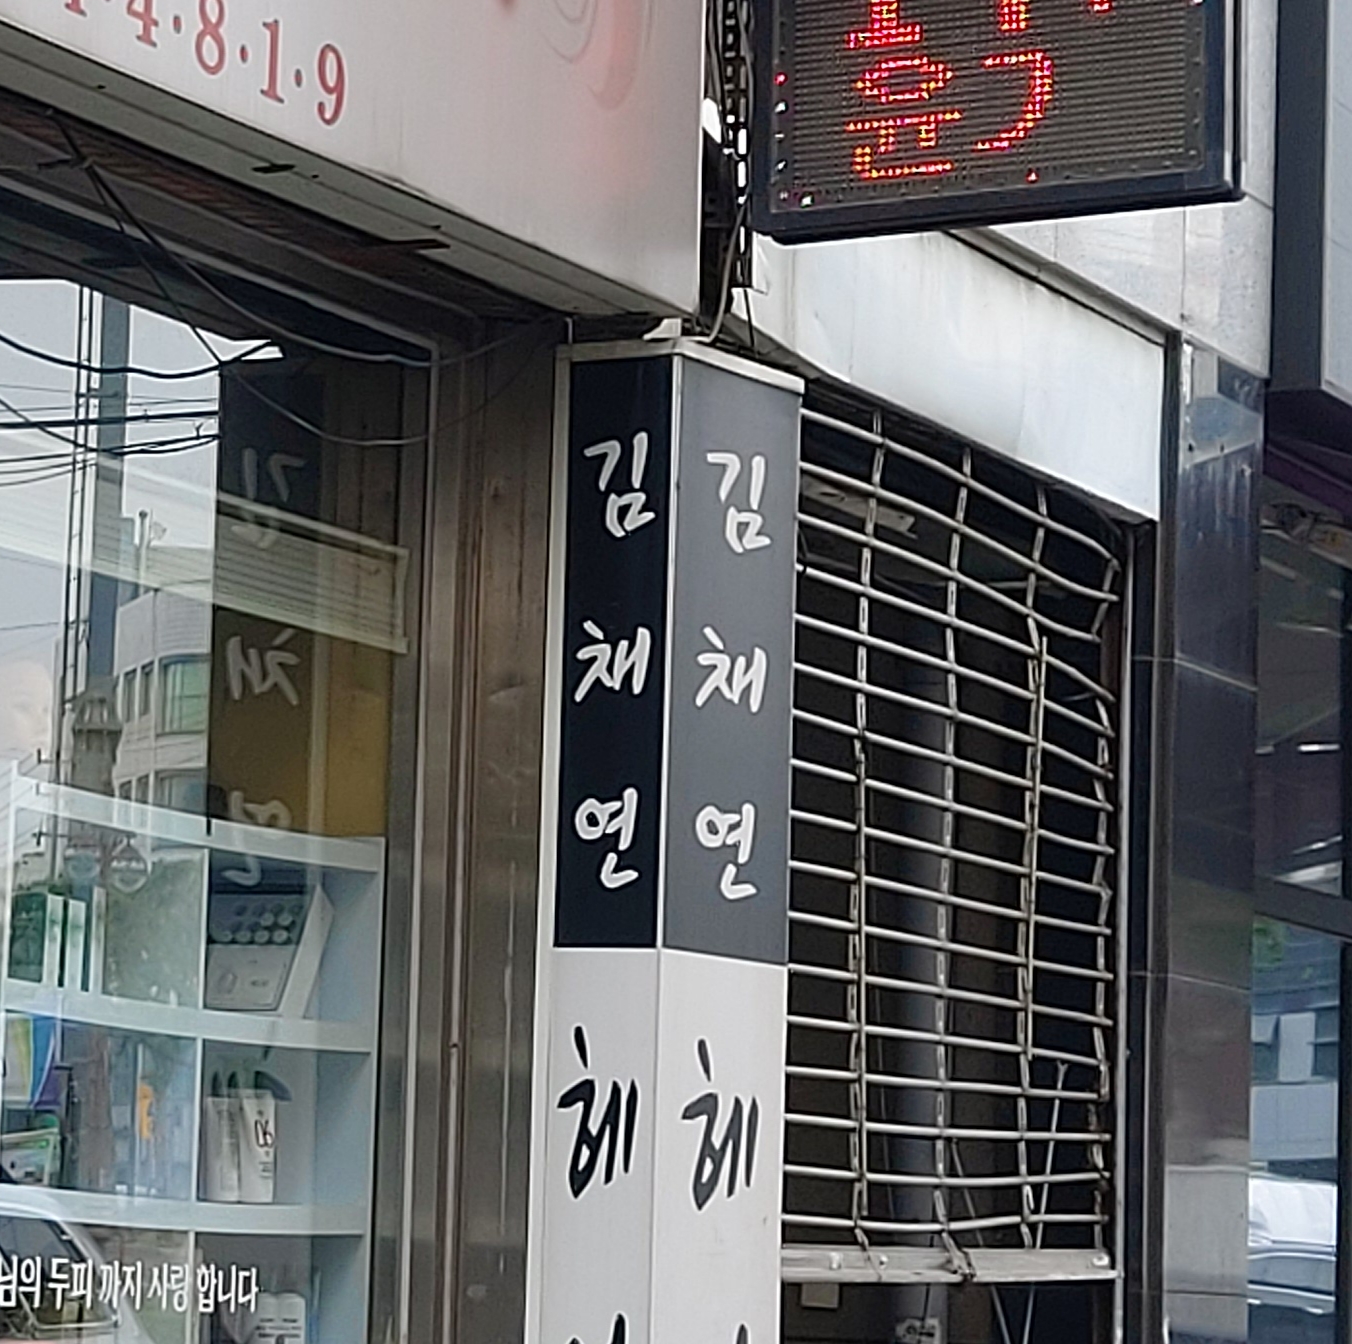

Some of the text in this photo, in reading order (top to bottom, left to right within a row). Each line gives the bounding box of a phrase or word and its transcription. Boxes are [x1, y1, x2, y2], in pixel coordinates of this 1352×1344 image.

[574, 432, 655, 889] 김채연
[695, 452, 771, 902] 김채연
[196, 1264, 259, 1314] 합니다
